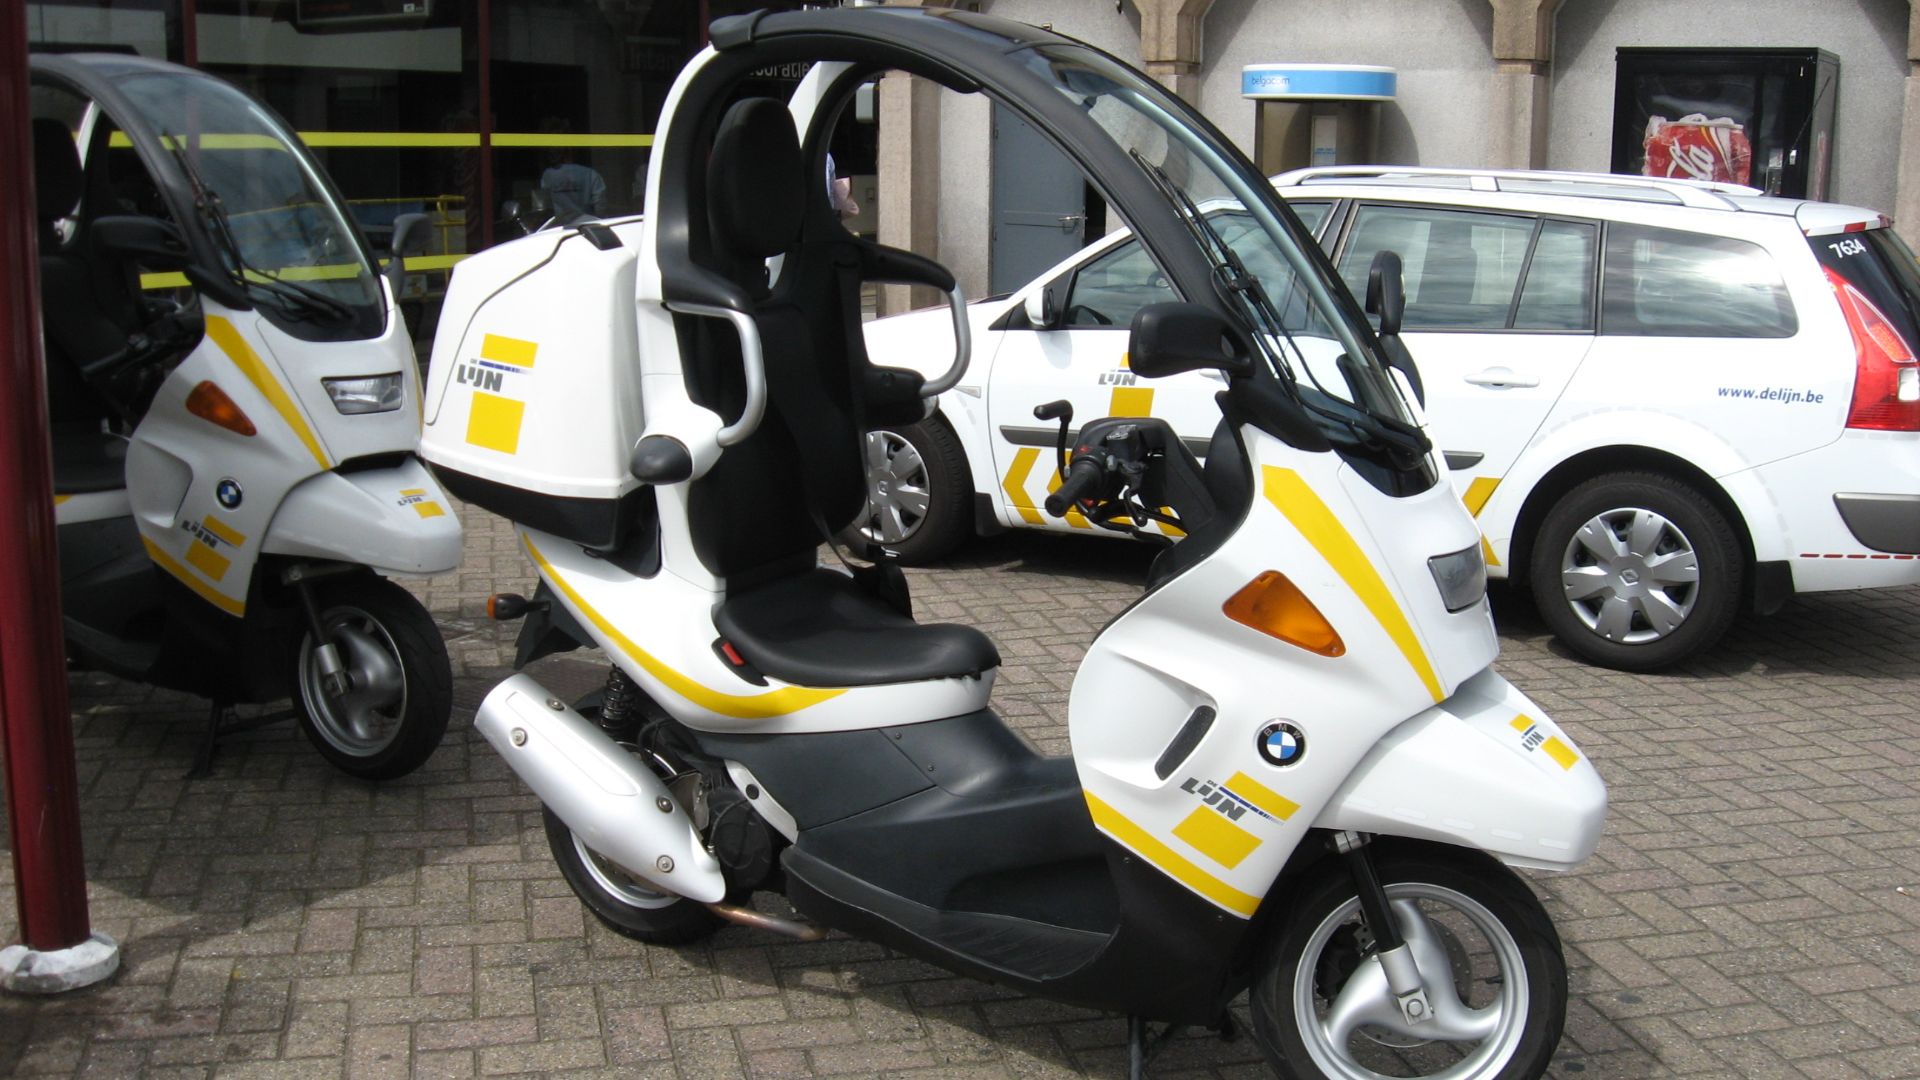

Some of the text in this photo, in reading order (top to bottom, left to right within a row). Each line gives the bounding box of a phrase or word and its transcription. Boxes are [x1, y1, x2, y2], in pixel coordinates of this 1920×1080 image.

[1828, 238, 1867, 258] 7634
[1718, 386, 1825, 404] www.delijn.be
[1263, 722, 1303, 740] BMW
